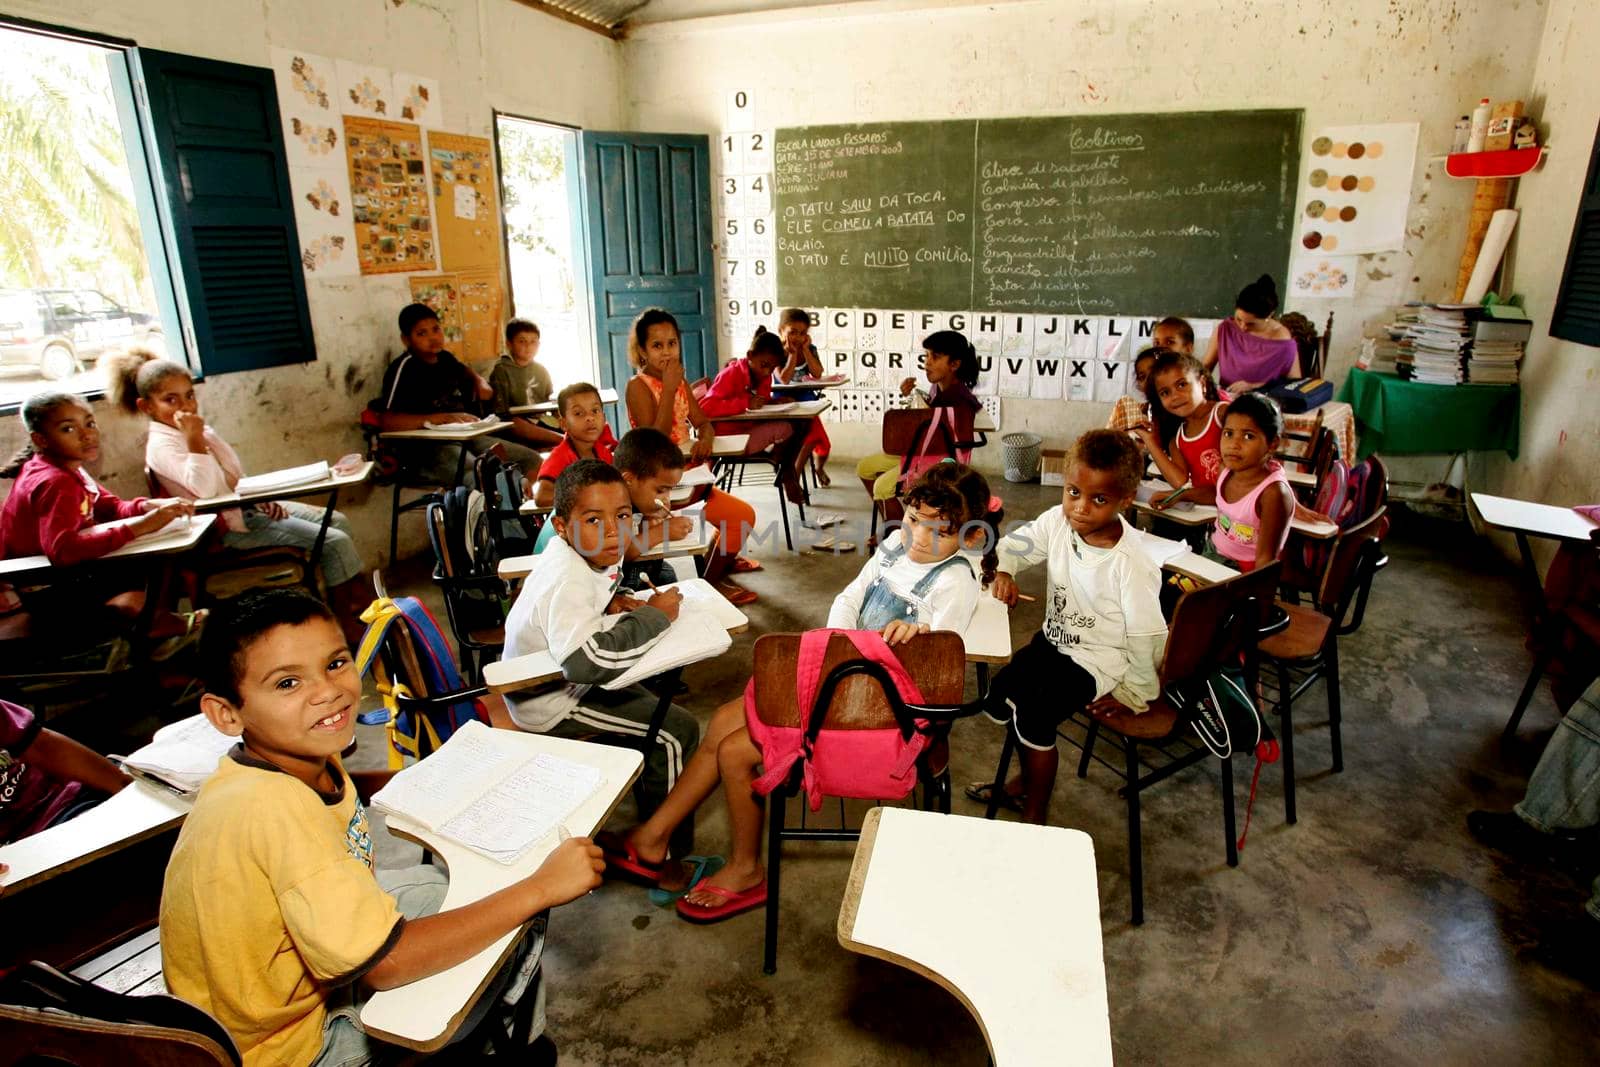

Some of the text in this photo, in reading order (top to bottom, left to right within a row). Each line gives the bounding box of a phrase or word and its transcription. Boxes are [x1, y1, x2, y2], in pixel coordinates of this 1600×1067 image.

[735, 91, 747, 108] 0
[723, 134, 763, 152] 1 2
[776, 139, 808, 152] ESCOLA
[1071, 127, 1143, 149] Coletivos
[807, 170, 848, 183] JULIANA
[725, 177, 763, 194] 3 4
[785, 206, 795, 217] O
[799, 202, 834, 214] TATU
[841, 198, 871, 211] SAIU
[879, 194, 899, 208] DA
[727, 219, 765, 235] 5 6
[787, 219, 813, 234] ELE
[822, 218, 871, 231] COMEU
[874, 217, 883, 228] A
[887, 210, 934, 226] BATATA
[784, 255, 794, 266] O
[799, 254, 828, 266] TATU
[840, 249, 849, 266] É
[864, 247, 909, 263] MUITO
[727, 260, 766, 276] 7 8
[728, 300, 773, 315] 9 10
[809, 312, 1156, 337] B C D E F G H I J K L M
[835, 353, 848, 367] P
[861, 352, 877, 368] Q
[889, 353, 903, 368] R
[1007, 359, 1023, 375] V
[1036, 360, 1058, 376] W
[1071, 361, 1087, 377] X
[1103, 363, 1119, 379] Y
